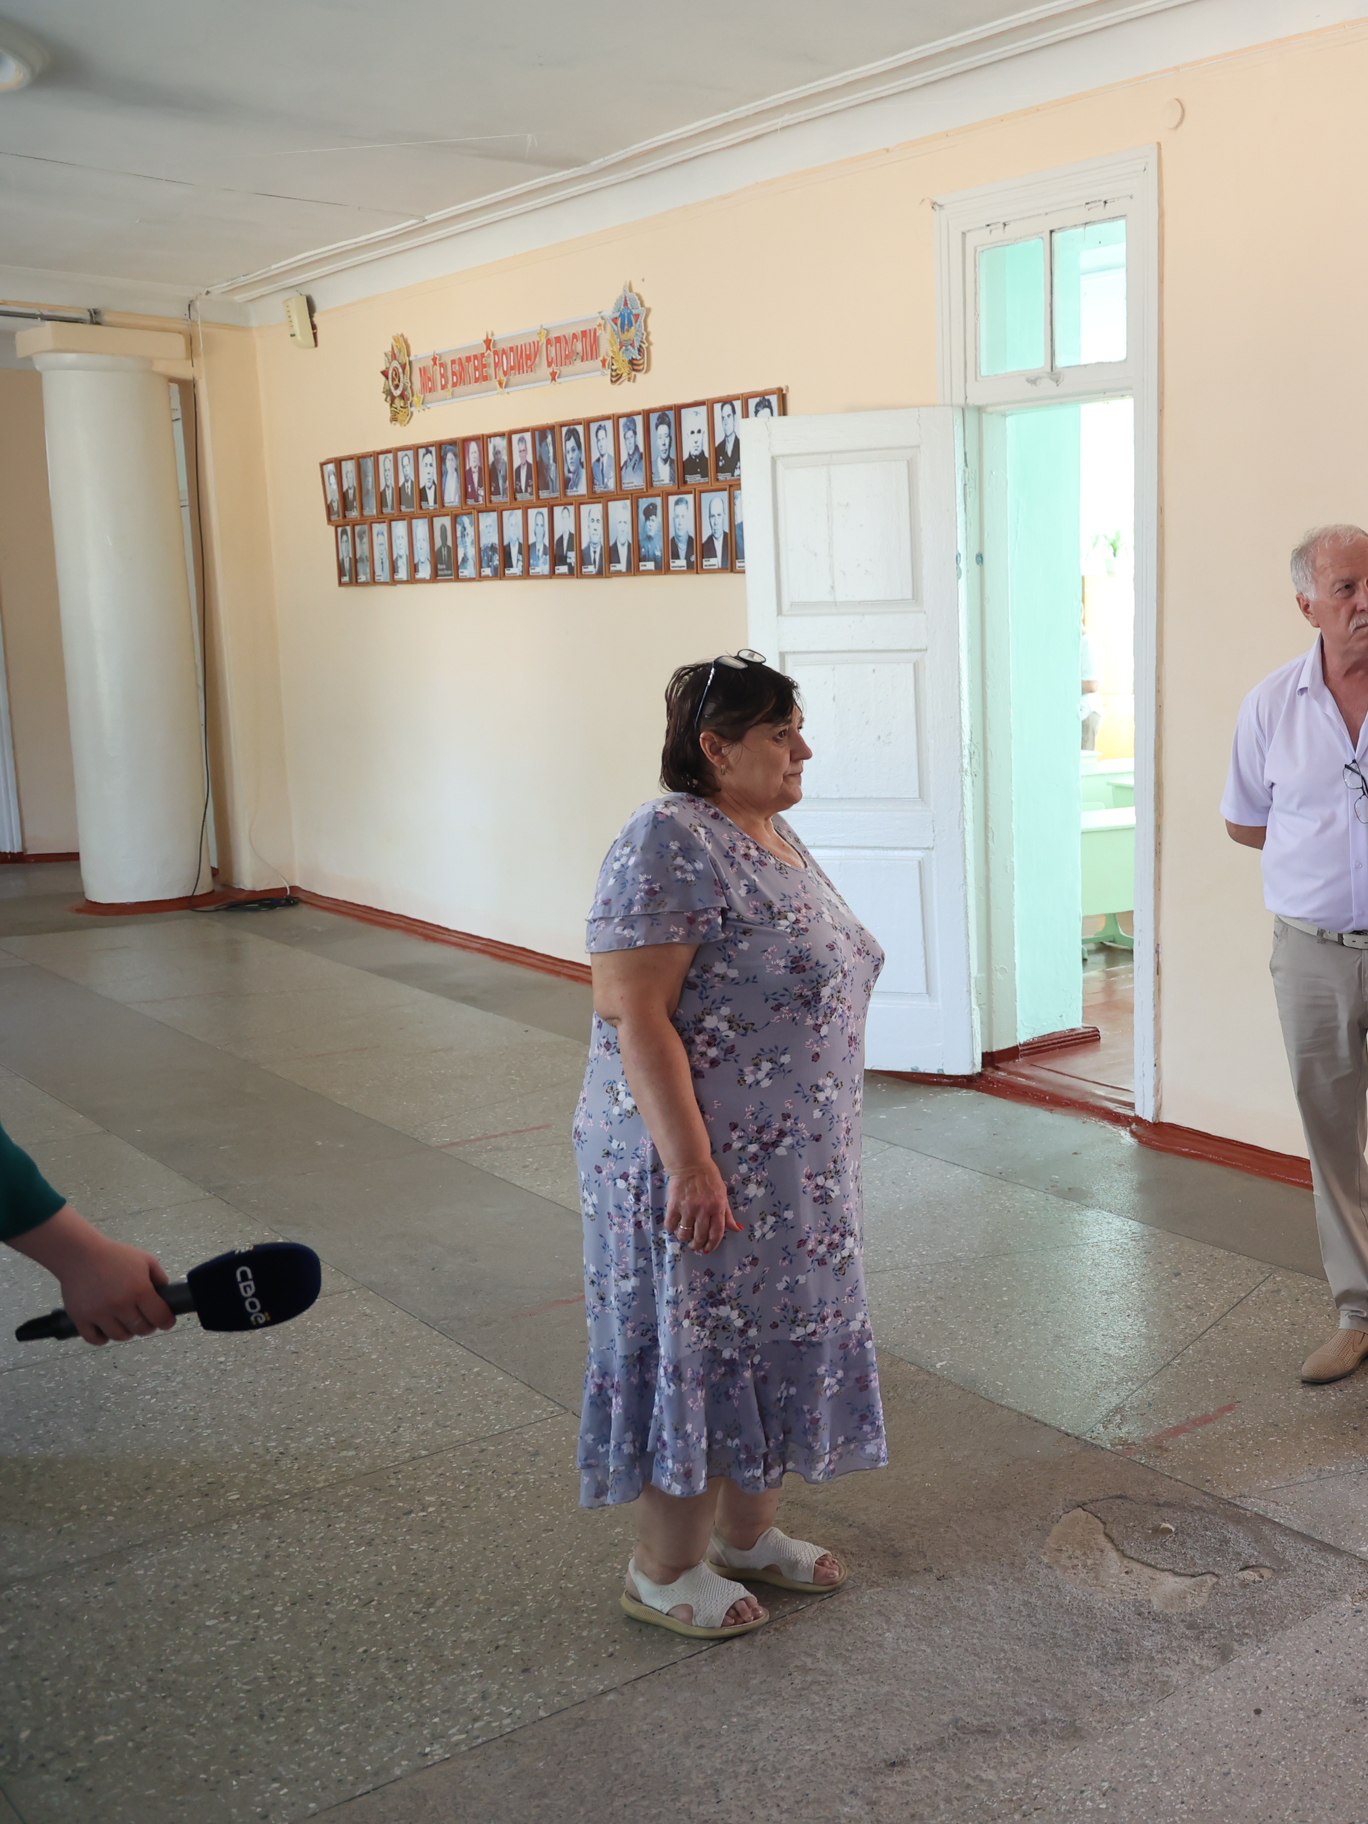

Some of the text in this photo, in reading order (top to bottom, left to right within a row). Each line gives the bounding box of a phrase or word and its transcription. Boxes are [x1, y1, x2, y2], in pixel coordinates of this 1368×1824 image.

[418, 364, 437, 395] МЫ
[439, 362, 447, 391] В
[450, 352, 489, 388] БАТВЕ
[493, 340, 540, 379] РОДИНУ
